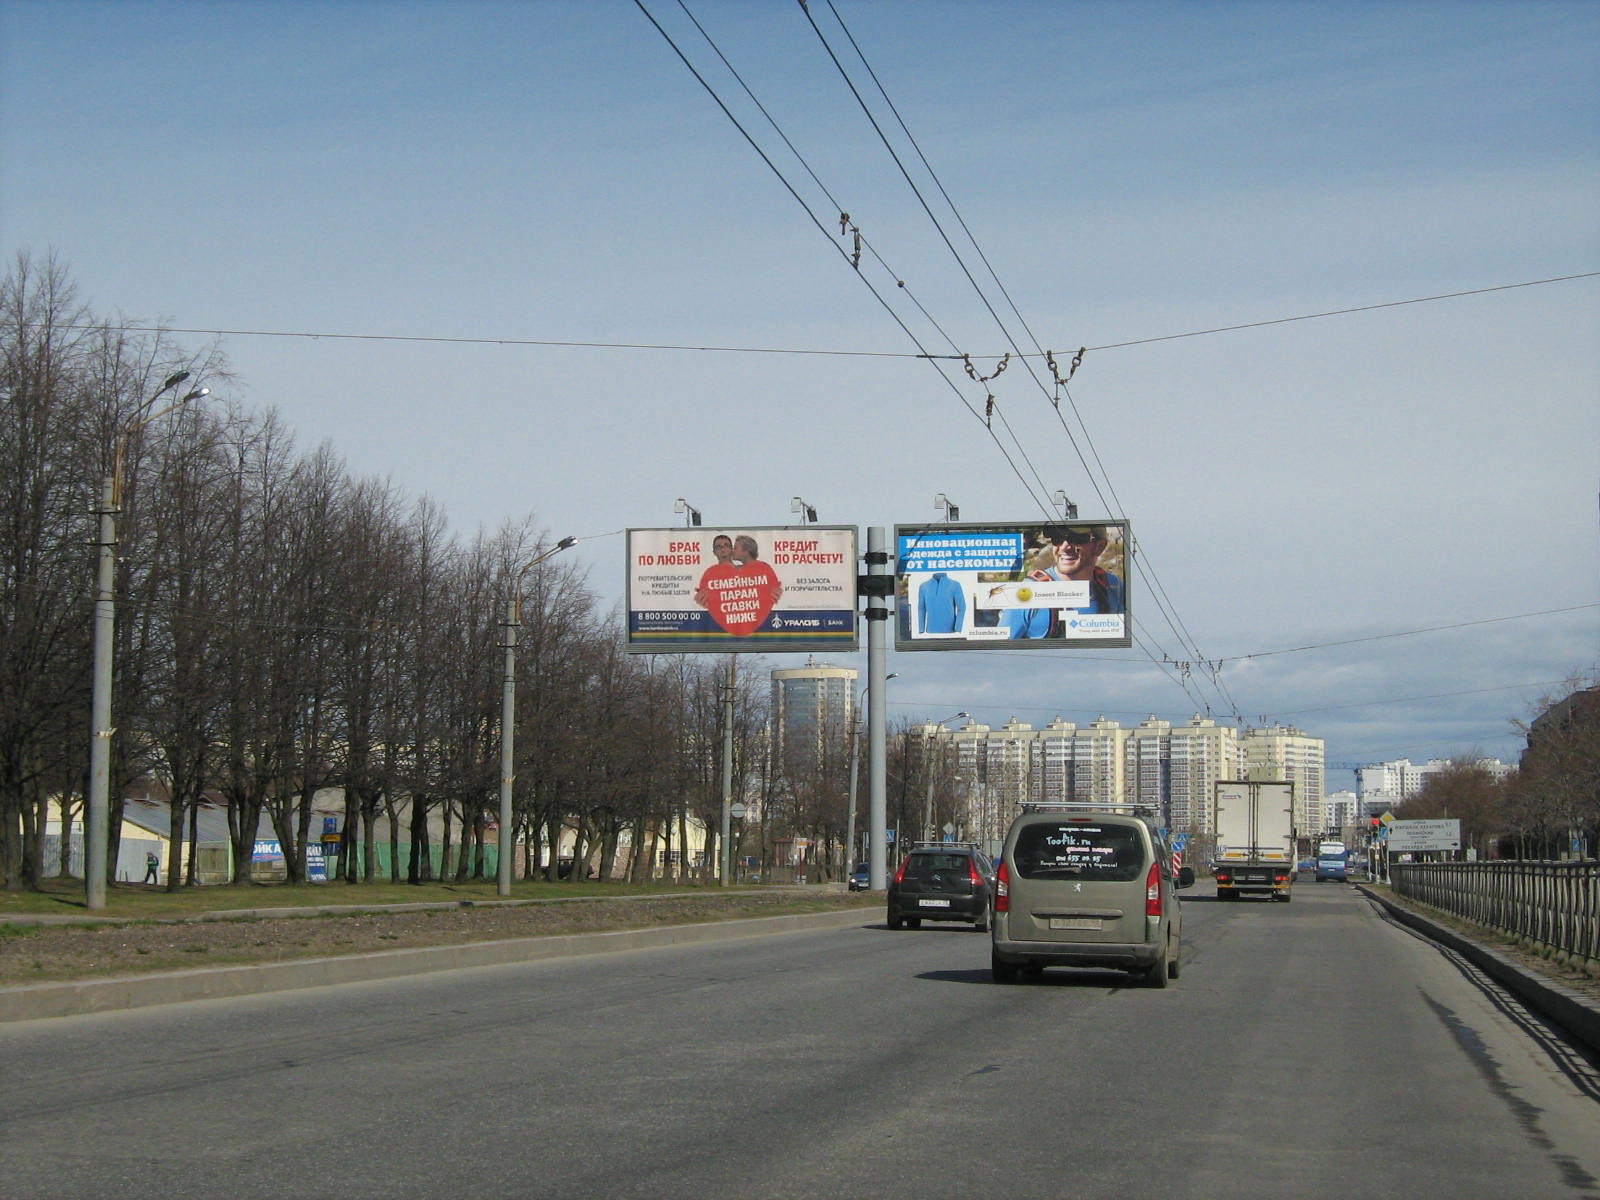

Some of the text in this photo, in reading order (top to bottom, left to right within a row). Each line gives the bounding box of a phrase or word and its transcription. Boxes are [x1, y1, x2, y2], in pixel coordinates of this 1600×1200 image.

[669, 542, 700, 552] БРАК
[774, 540, 818, 552] КРЕДИТ
[774, 553, 844, 564] ПО РАСЧЕТУ!
[964, 548, 1017, 557] защитой
[638, 554, 700, 566] ПО ЛЮБВИ
[906, 557, 1017, 569] от насекомых
[708, 575, 768, 590] СЕМЕЙНЫМ
[720, 589, 758, 601] ПАРАМ
[720, 601, 760, 613] СТАВКИ
[638, 612, 700, 620] 8 800 500 00 00
[726, 612, 757, 624] НИЖЕ
[784, 618, 820, 626] УРАЛСИБ
